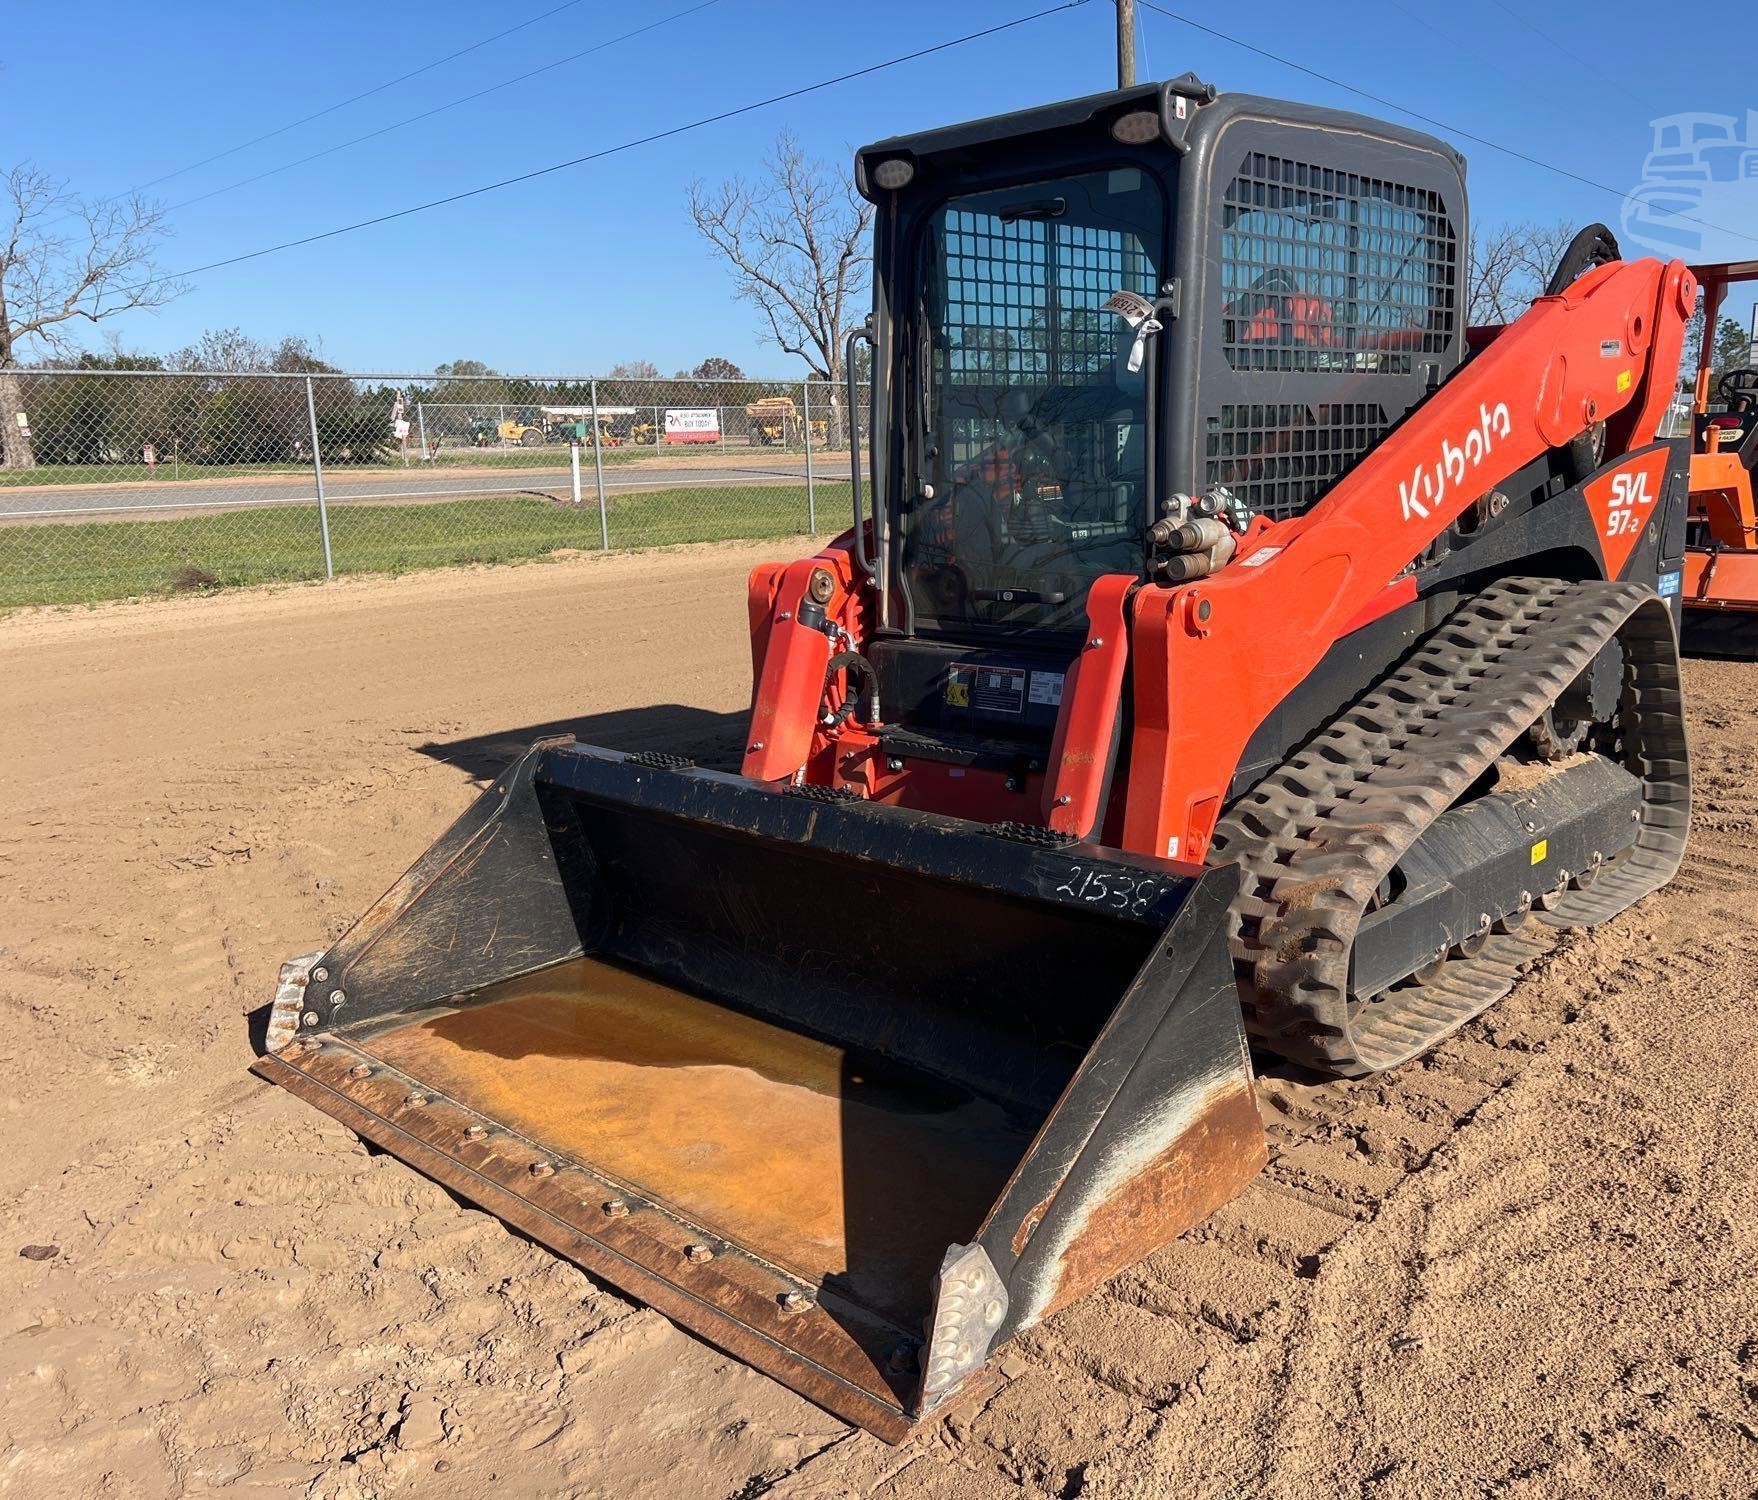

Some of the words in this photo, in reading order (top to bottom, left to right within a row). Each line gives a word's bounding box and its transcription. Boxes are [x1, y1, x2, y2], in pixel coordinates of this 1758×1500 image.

[1398, 402, 1511, 521] Kubota
[1608, 472, 1652, 507] SVL
[1606, 510, 1639, 536] 97-2
